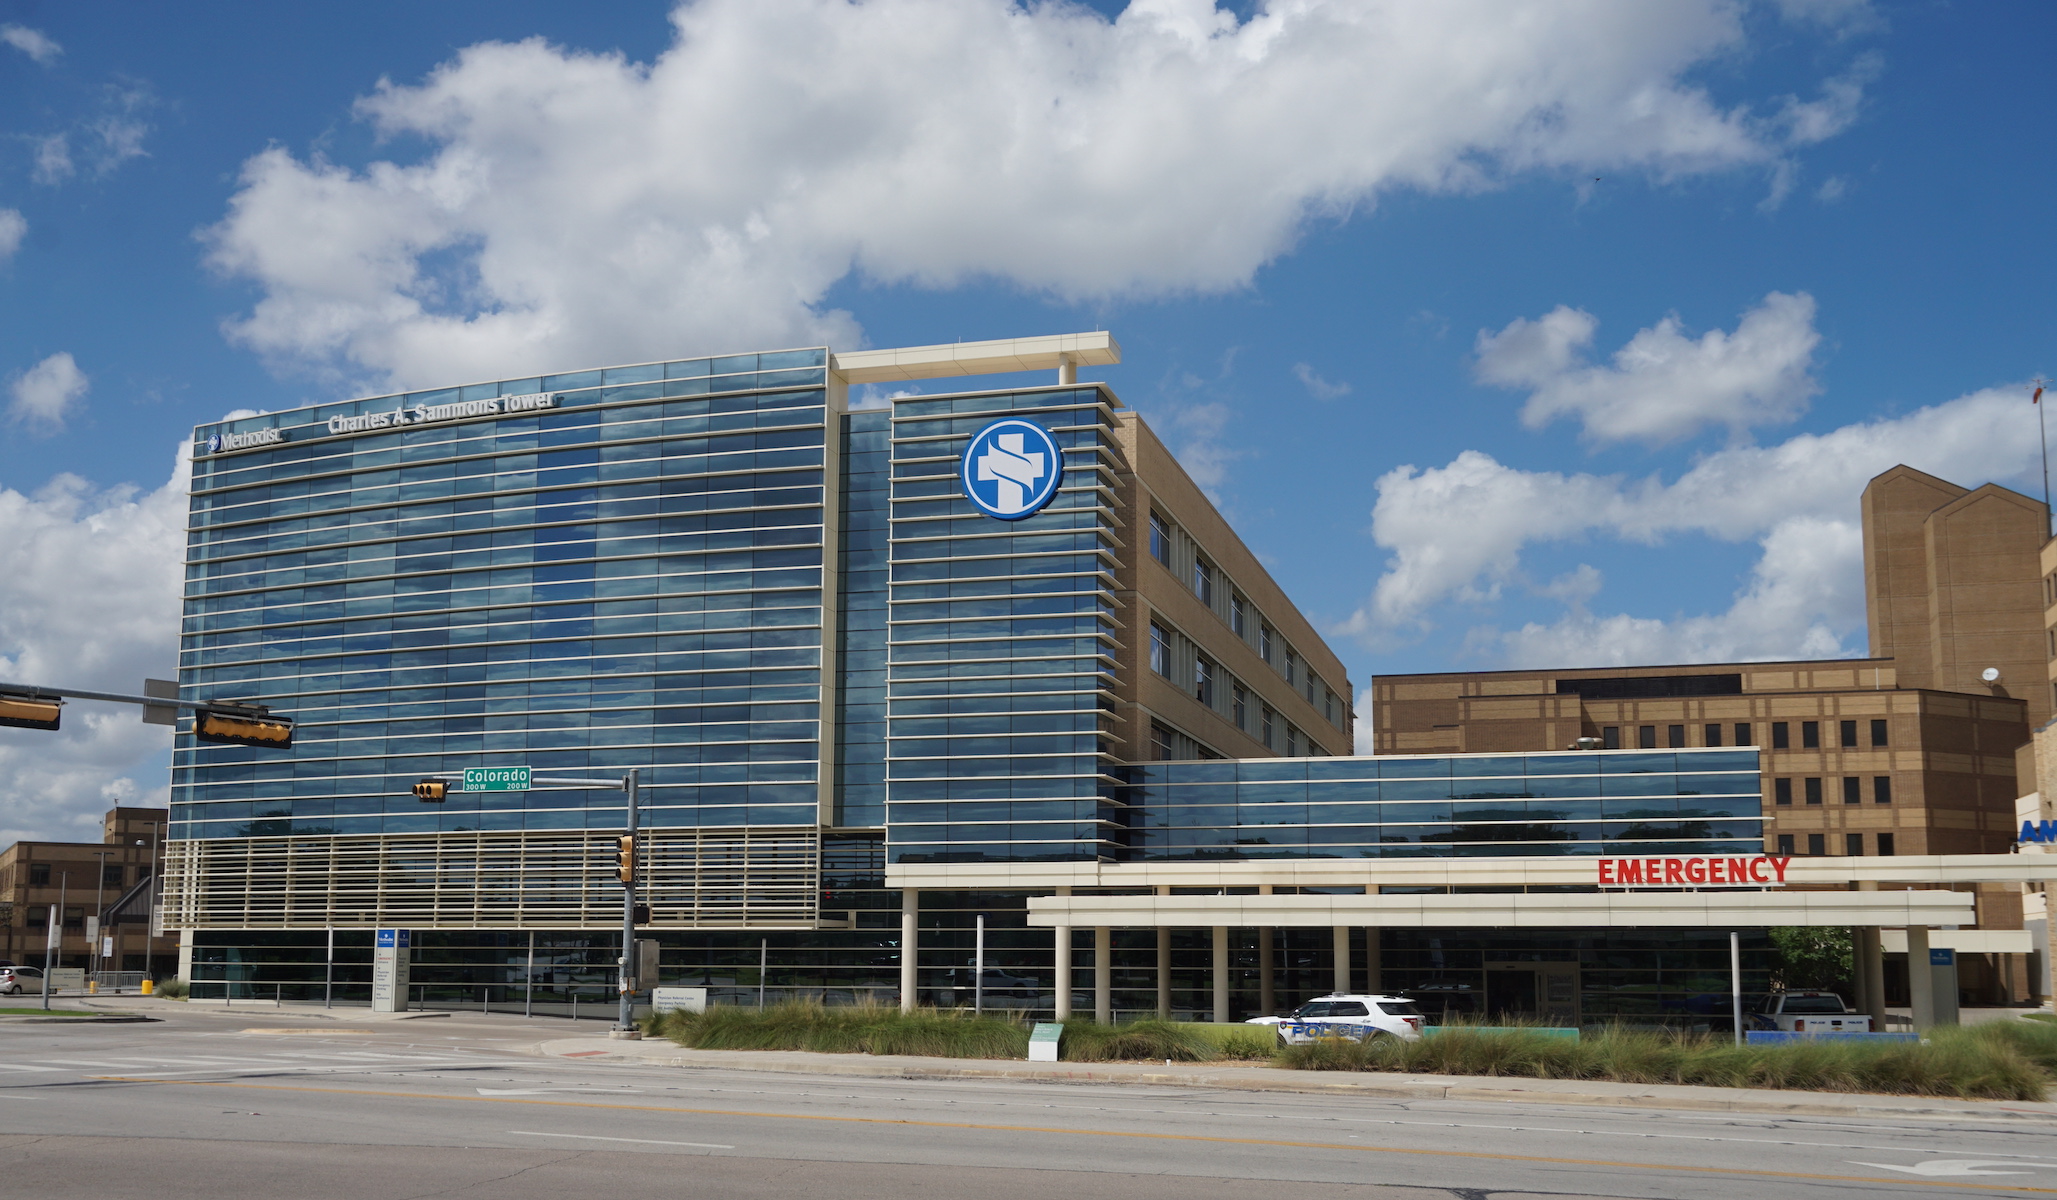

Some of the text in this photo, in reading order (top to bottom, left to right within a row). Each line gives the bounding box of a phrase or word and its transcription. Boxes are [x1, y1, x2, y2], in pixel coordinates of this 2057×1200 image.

[328, 392, 556, 434] Charles A. Sammons Tower
[221, 427, 282, 451] Methodist
[466, 769, 527, 782] Colorado
[1598, 857, 1791, 884] EMERGENCY
